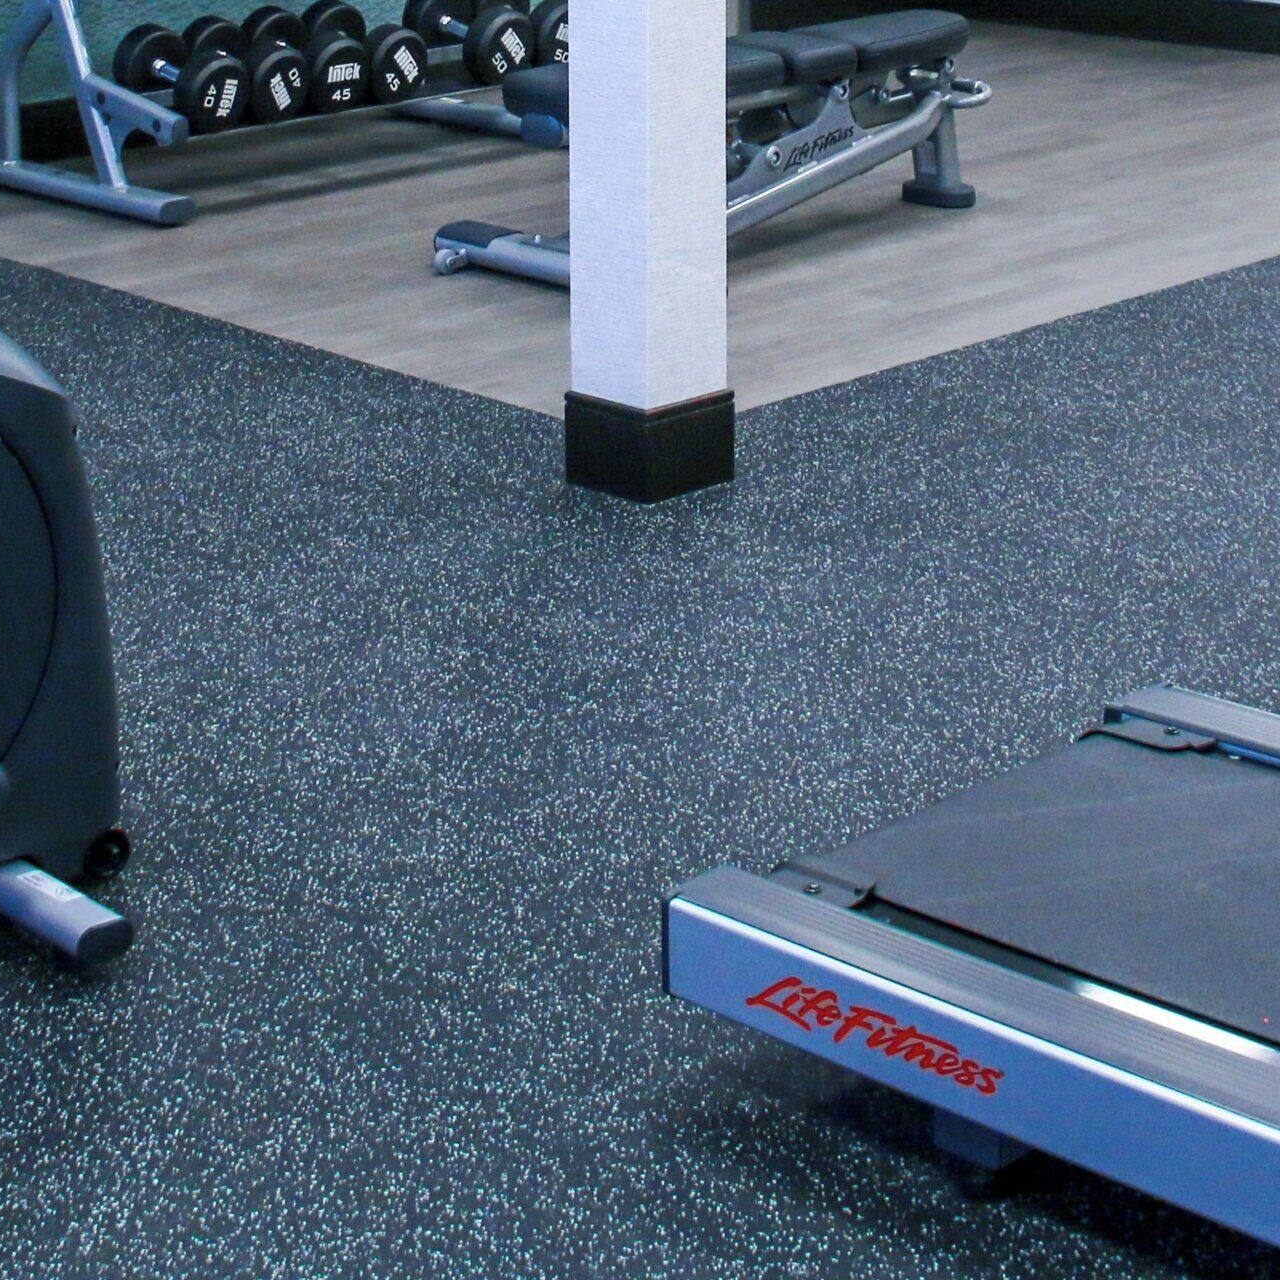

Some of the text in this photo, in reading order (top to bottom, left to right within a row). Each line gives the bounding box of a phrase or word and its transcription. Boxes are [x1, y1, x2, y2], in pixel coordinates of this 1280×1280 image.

[492, 52, 508, 74] 50
[554, 48, 568, 63] 50
[288, 68, 301, 88] 40
[385, 72, 401, 92] 45
[204, 84, 217, 108] 40
[332, 88, 351, 101] 45
